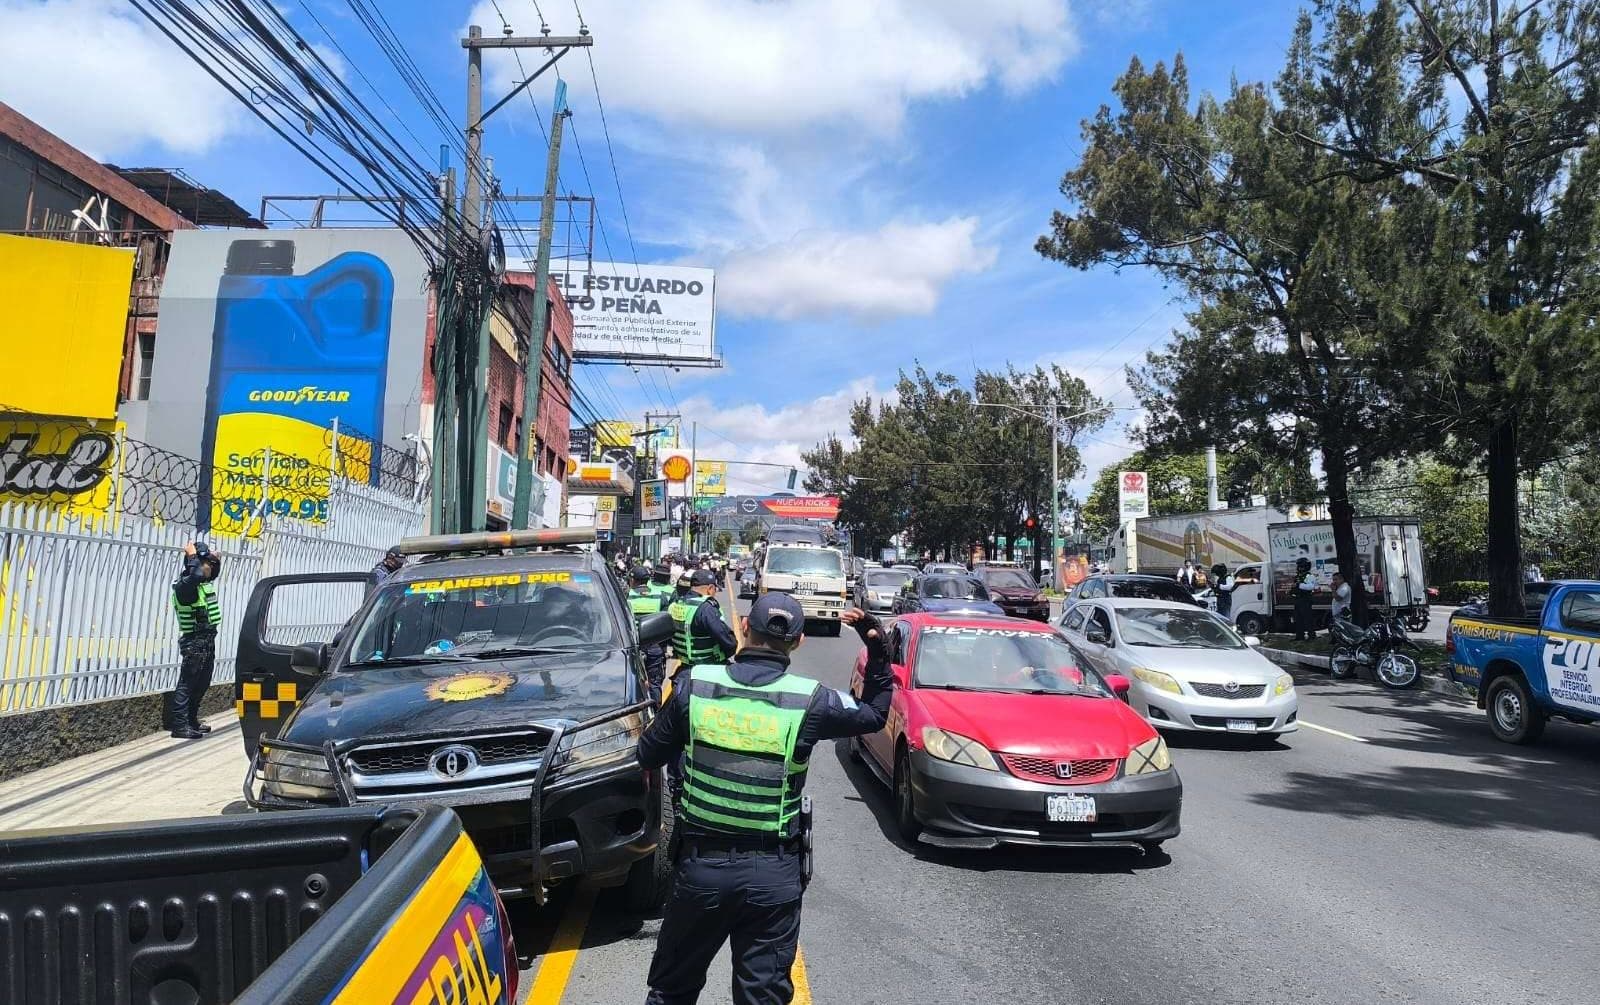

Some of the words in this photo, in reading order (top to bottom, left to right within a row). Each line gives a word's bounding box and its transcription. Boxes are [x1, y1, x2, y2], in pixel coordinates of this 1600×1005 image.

[583, 274, 704, 296] ESTUARDO
[601, 294, 663, 315] PEÑA
[624, 316, 665, 326] Publicidad
[666, 319, 697, 327] Exterior
[249, 386, 350, 405] GOODYEAR
[776, 498, 804, 506] NUEVA
[805, 499, 830, 507] KICKS
[1272, 535, 1300, 548] White
[1303, 531, 1335, 543] Cotton
[409, 575, 521, 593] TRANSITO
[527, 572, 571, 584] PNC
[1451, 624, 1500, 641] COMISARIA
[1563, 670, 1588, 682] SERVICIO
[1560, 679, 1593, 694] INTEGRIDAD
